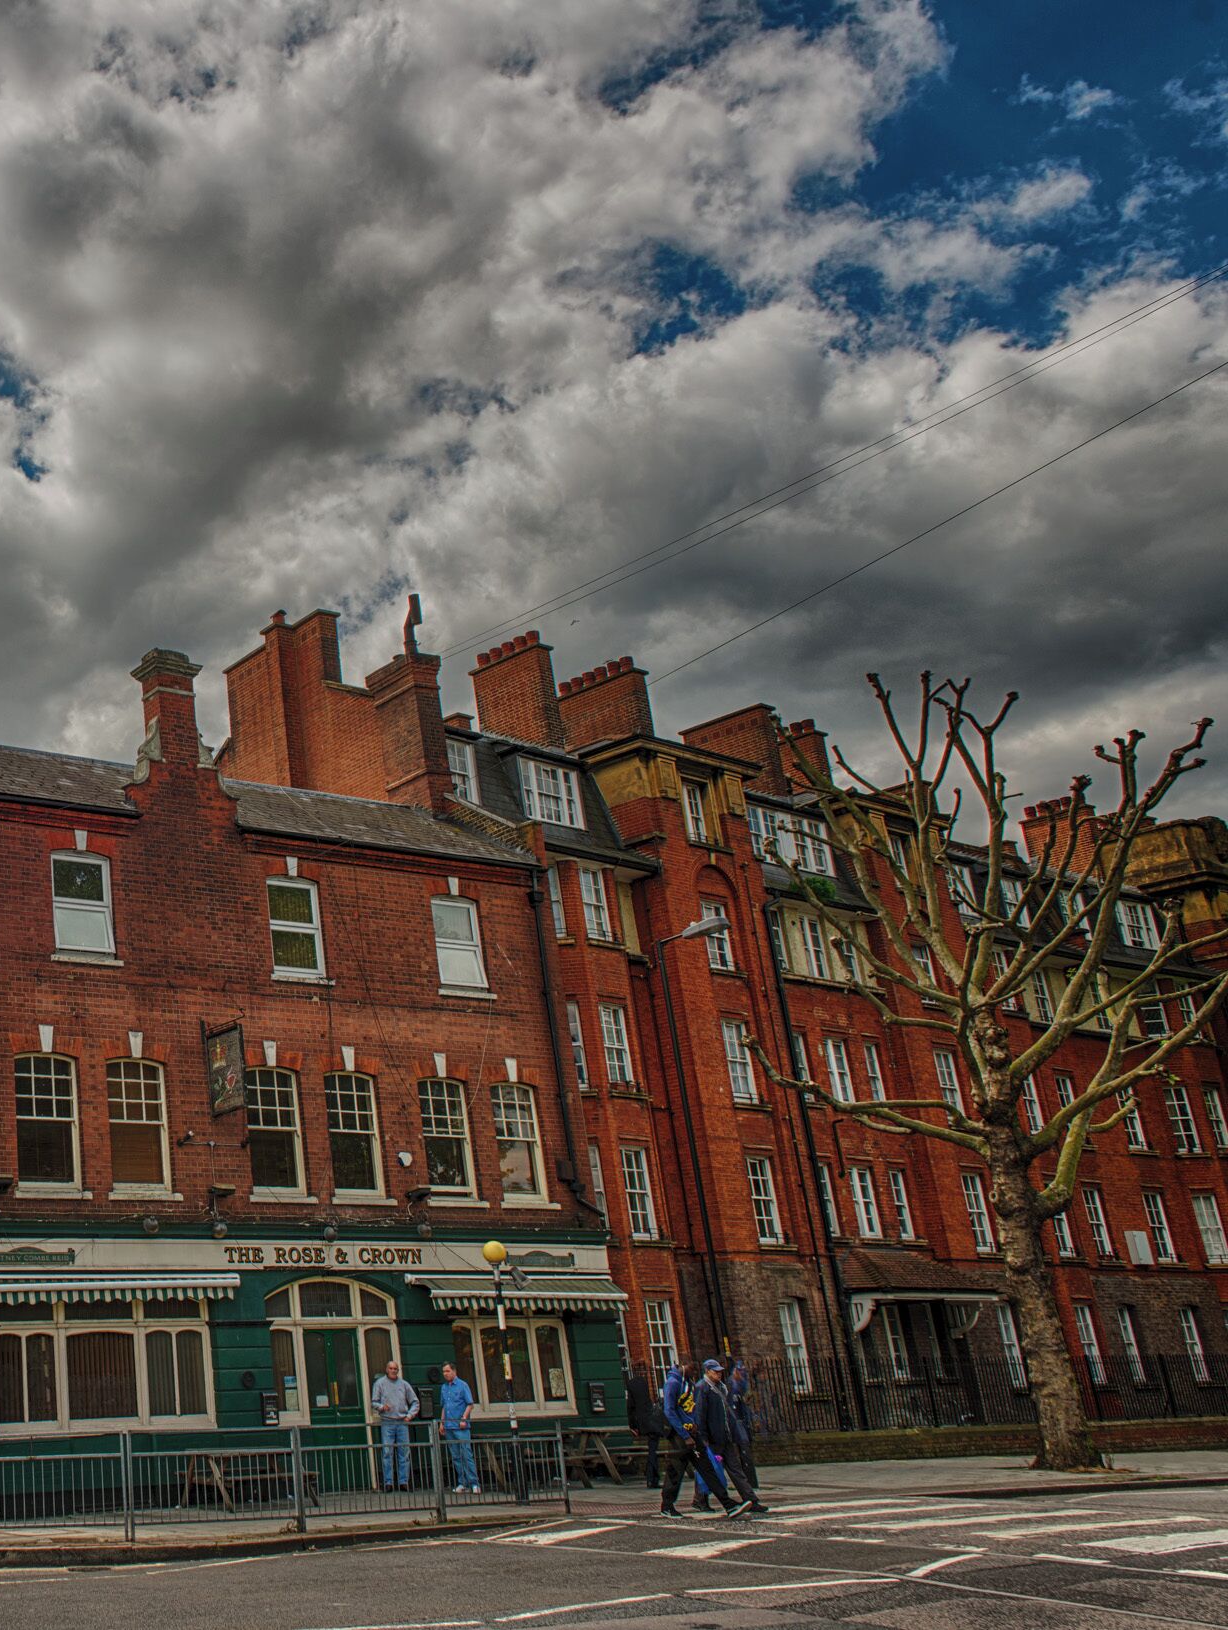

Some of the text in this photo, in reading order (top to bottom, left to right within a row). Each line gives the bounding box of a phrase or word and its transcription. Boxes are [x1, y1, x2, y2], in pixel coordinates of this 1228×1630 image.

[224, 1246, 423, 1265] THE ROSE & CROWN
